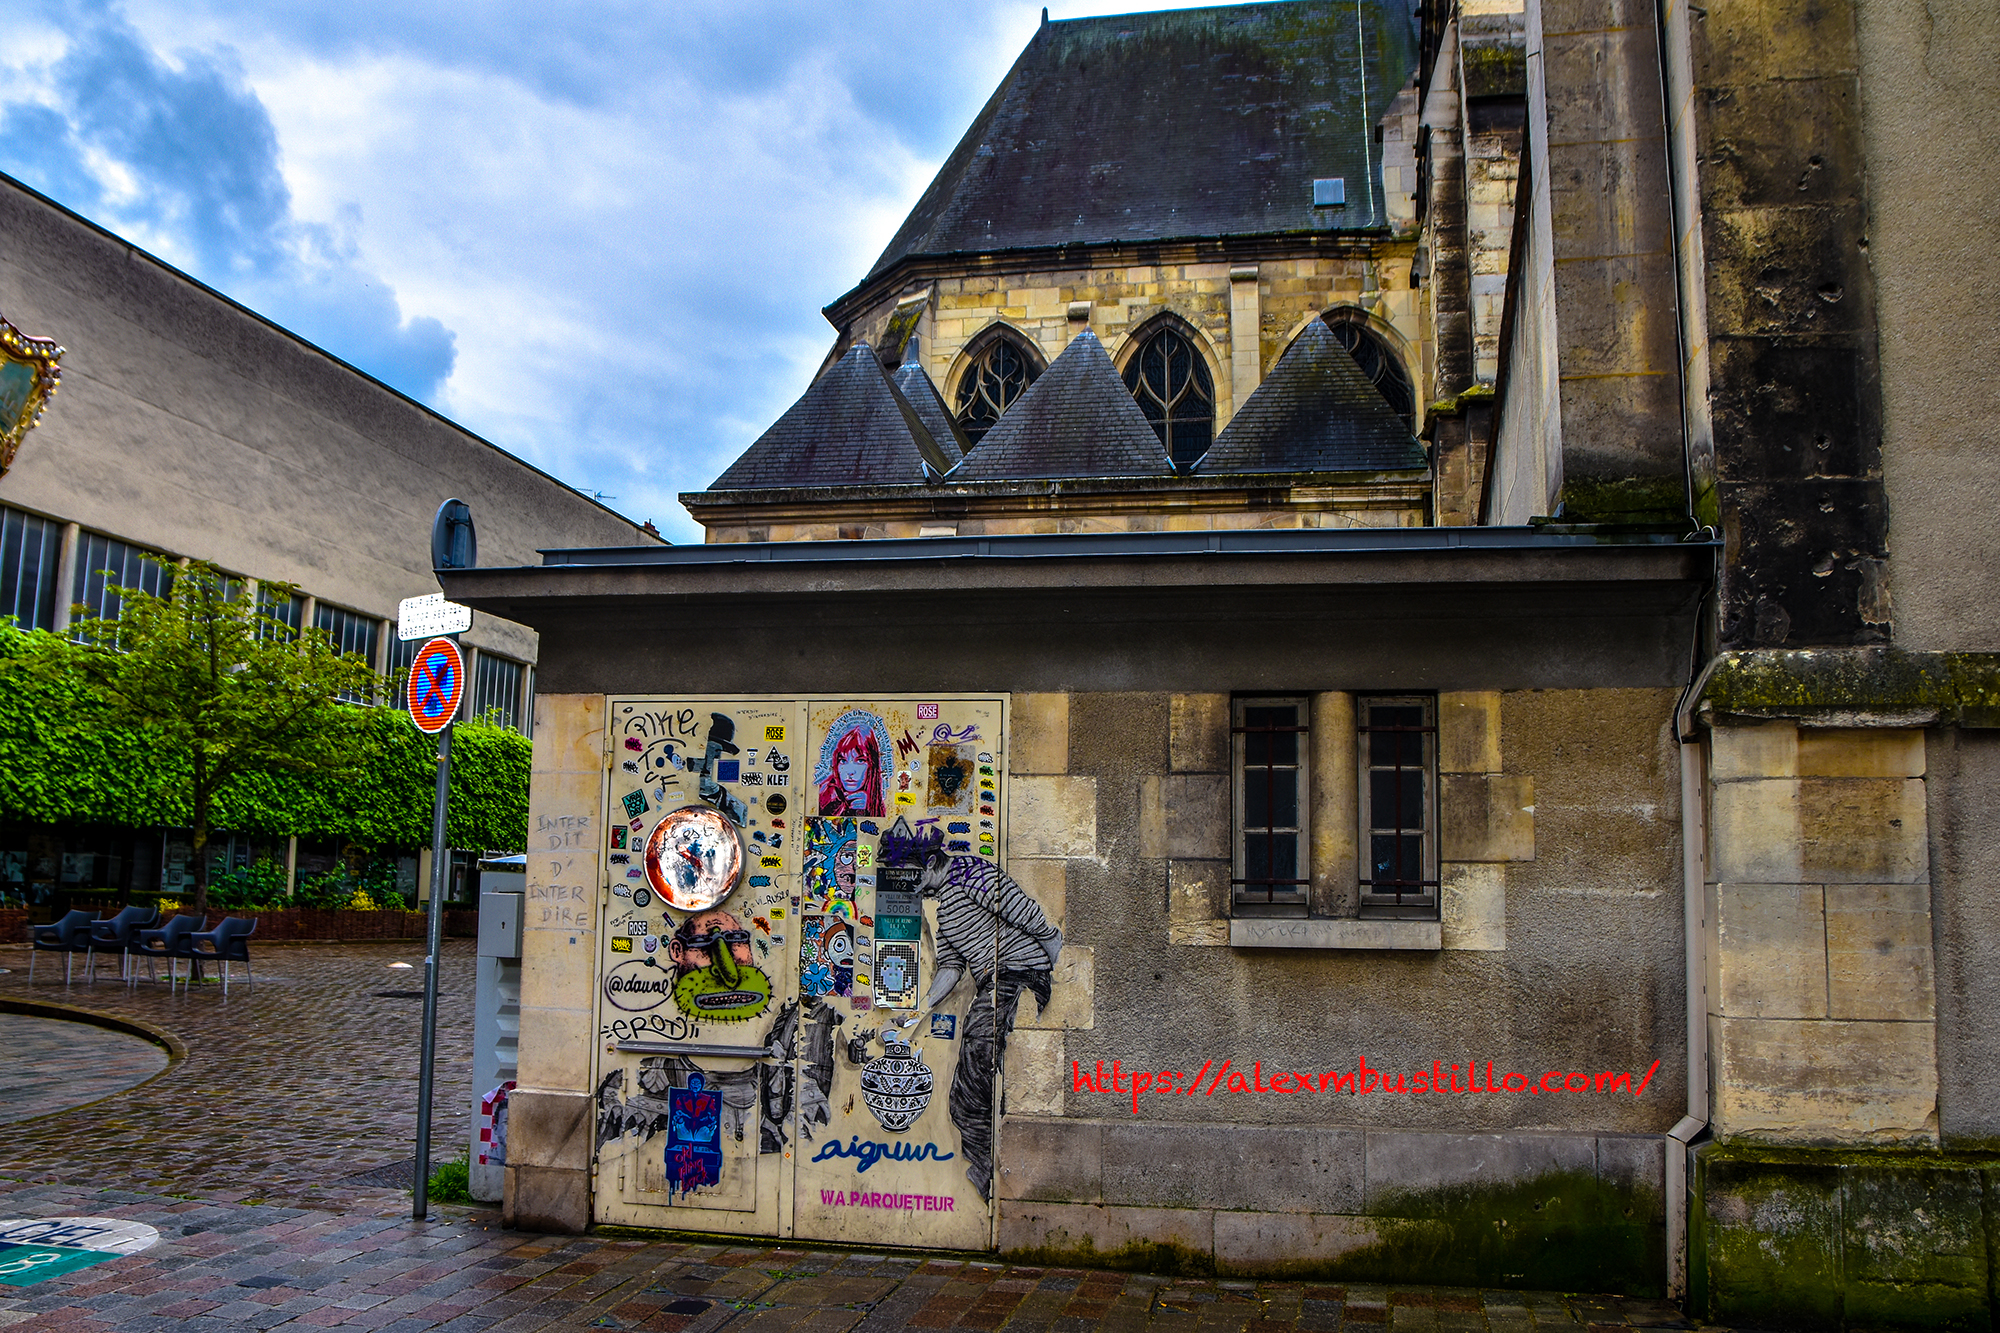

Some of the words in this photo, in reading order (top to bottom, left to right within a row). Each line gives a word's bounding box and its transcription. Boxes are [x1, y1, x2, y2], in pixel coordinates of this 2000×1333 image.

[918, 706, 938, 717] ROSE
[765, 727, 784, 740] ROSE
[767, 774, 789, 786] KLET
[537, 815, 591, 832] INTER
[886, 905, 911, 914] 5008
[628, 921, 647, 935] ROSE
